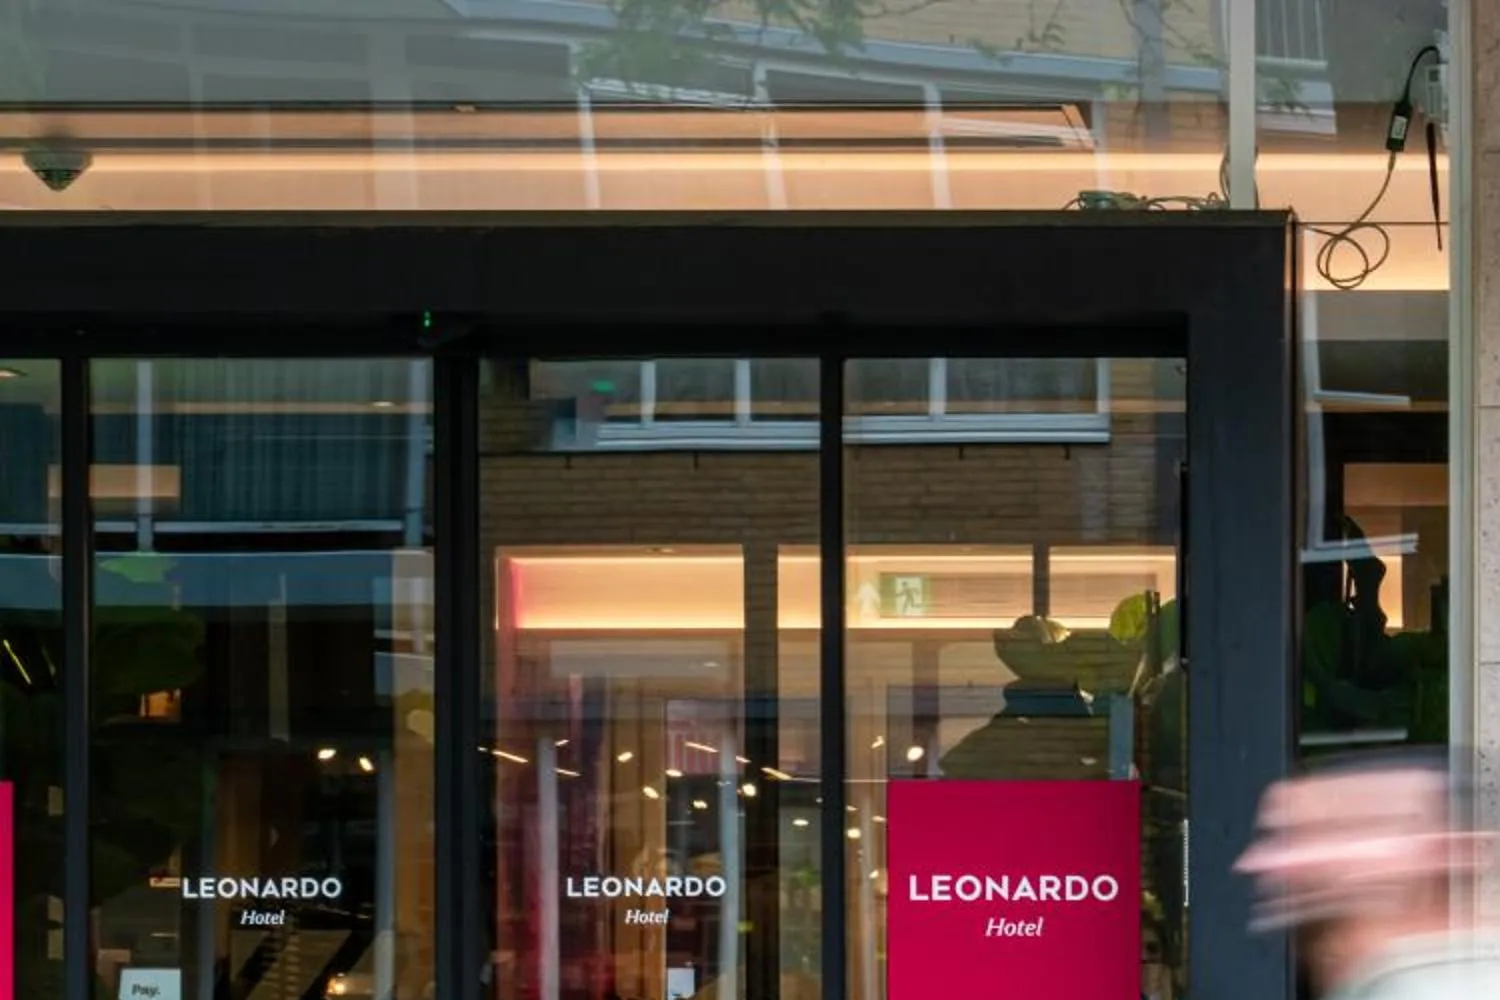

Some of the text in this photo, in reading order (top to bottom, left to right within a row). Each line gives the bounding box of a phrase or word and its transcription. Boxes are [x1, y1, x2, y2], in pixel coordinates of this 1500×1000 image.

[182, 876, 343, 900] LEONARDO
[566, 875, 728, 898] LEONARDO
[908, 874, 1120, 902] LEONARDO
[240, 908, 286, 926] Hotel
[624, 907, 670, 925] Hotel
[985, 916, 1045, 938] Hotel
